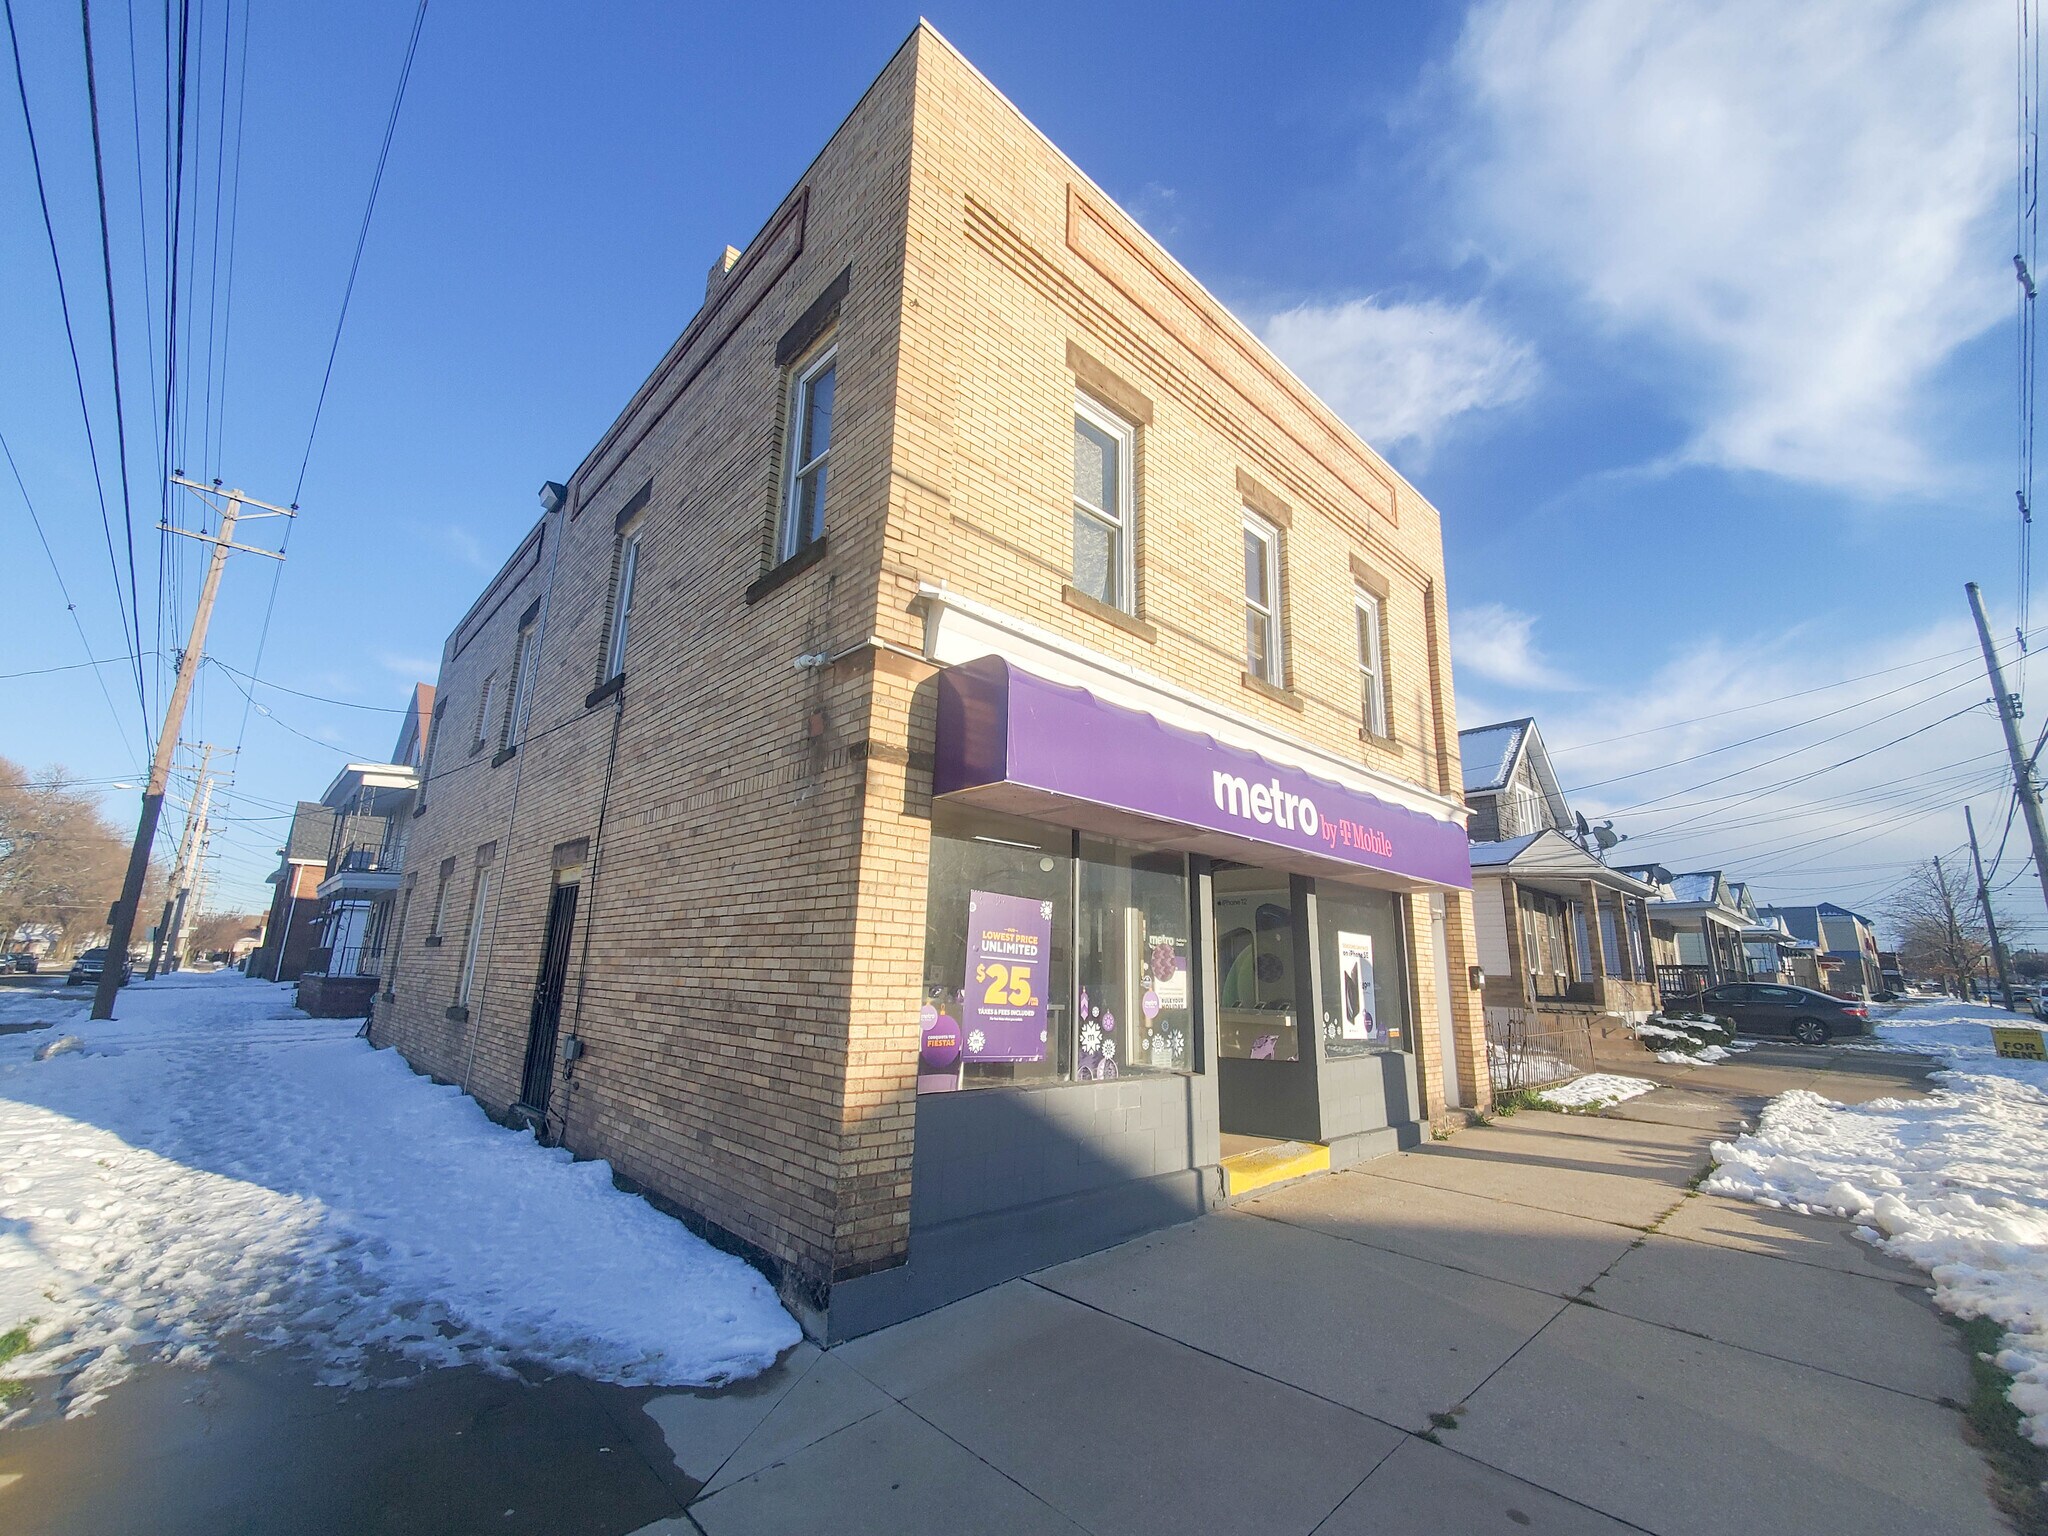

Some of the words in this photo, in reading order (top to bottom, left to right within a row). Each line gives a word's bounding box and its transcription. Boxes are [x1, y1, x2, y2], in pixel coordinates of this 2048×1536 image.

[1213, 771, 1318, 836] metro
[1320, 814, 1337, 848] by
[982, 930, 1014, 942] LOWEST
[1015, 934, 1038, 945] PRICE
[1149, 934, 1175, 946] metro
[981, 940, 1038, 956] UNLIMITED
[1011, 1009, 1035, 1017] INCLUDED
[927, 1039, 956, 1048] FIESTAS
[2002, 1041, 2036, 1050] FOR
[1999, 1050, 2044, 1060] RENT
